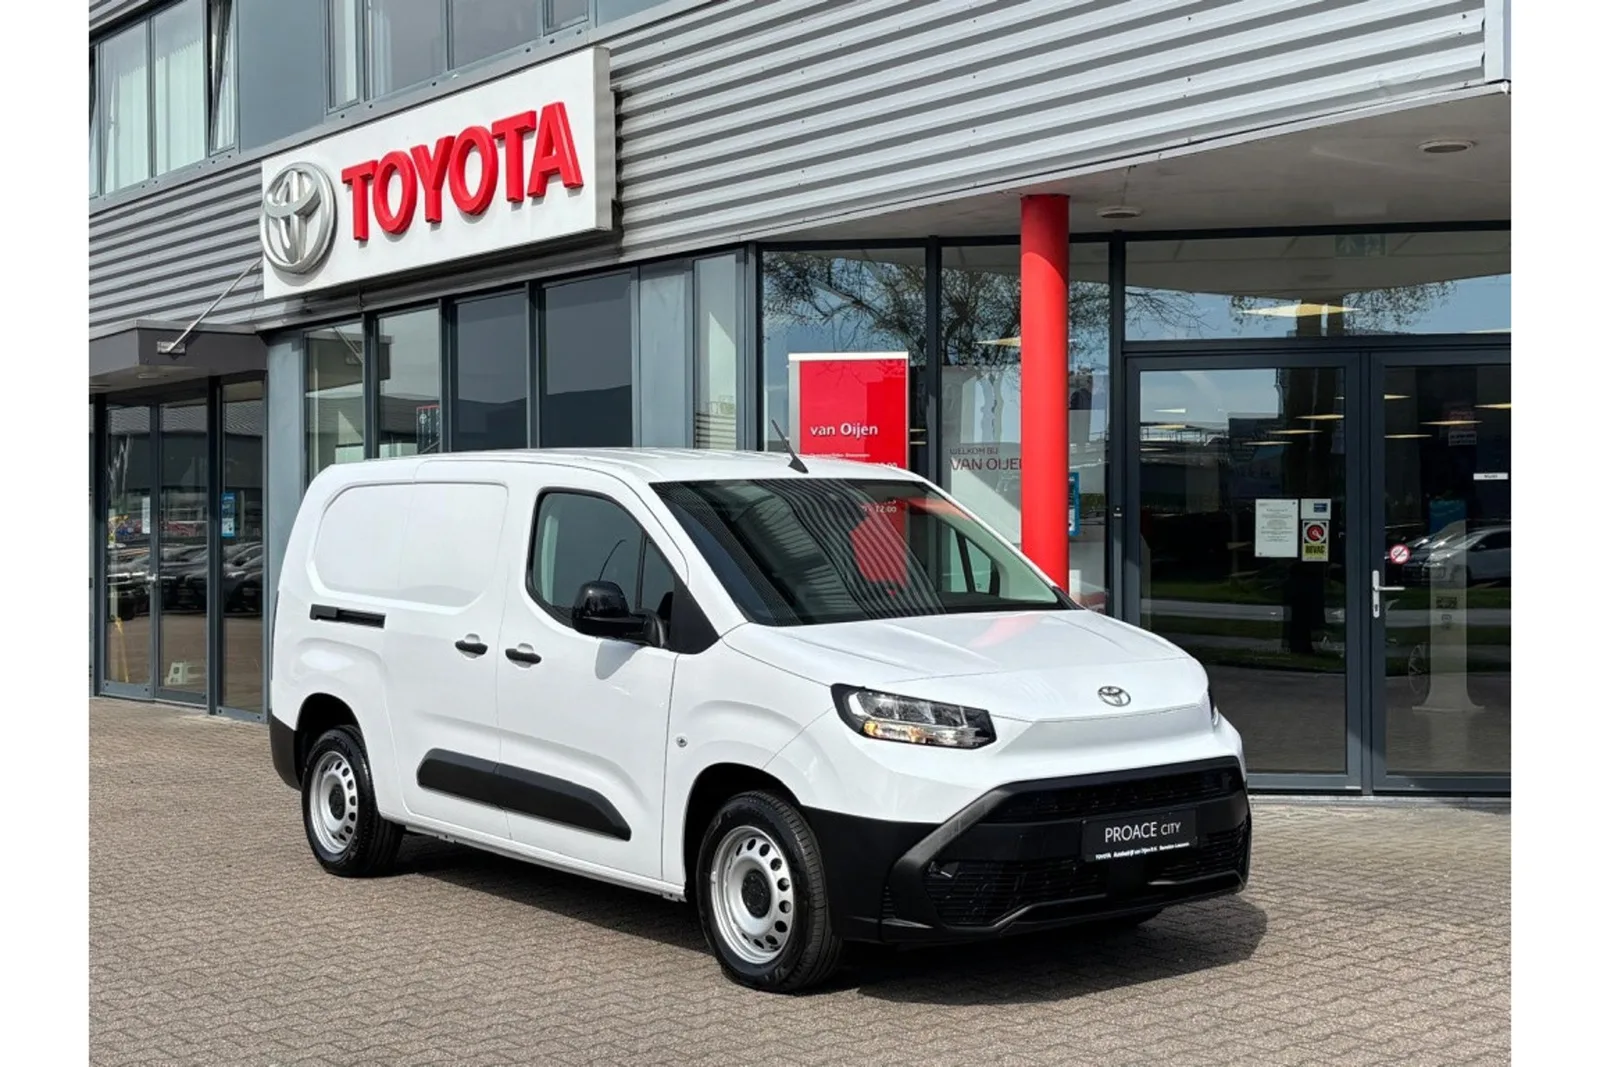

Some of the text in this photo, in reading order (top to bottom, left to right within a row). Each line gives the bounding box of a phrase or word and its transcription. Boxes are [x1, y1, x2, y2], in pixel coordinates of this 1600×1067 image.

[341, 102, 583, 241] TOYOTA
[810, 422, 879, 439] van Oijen
[950, 458, 983, 471] VAN
[1105, 821, 1181, 843] PROACE CITY
